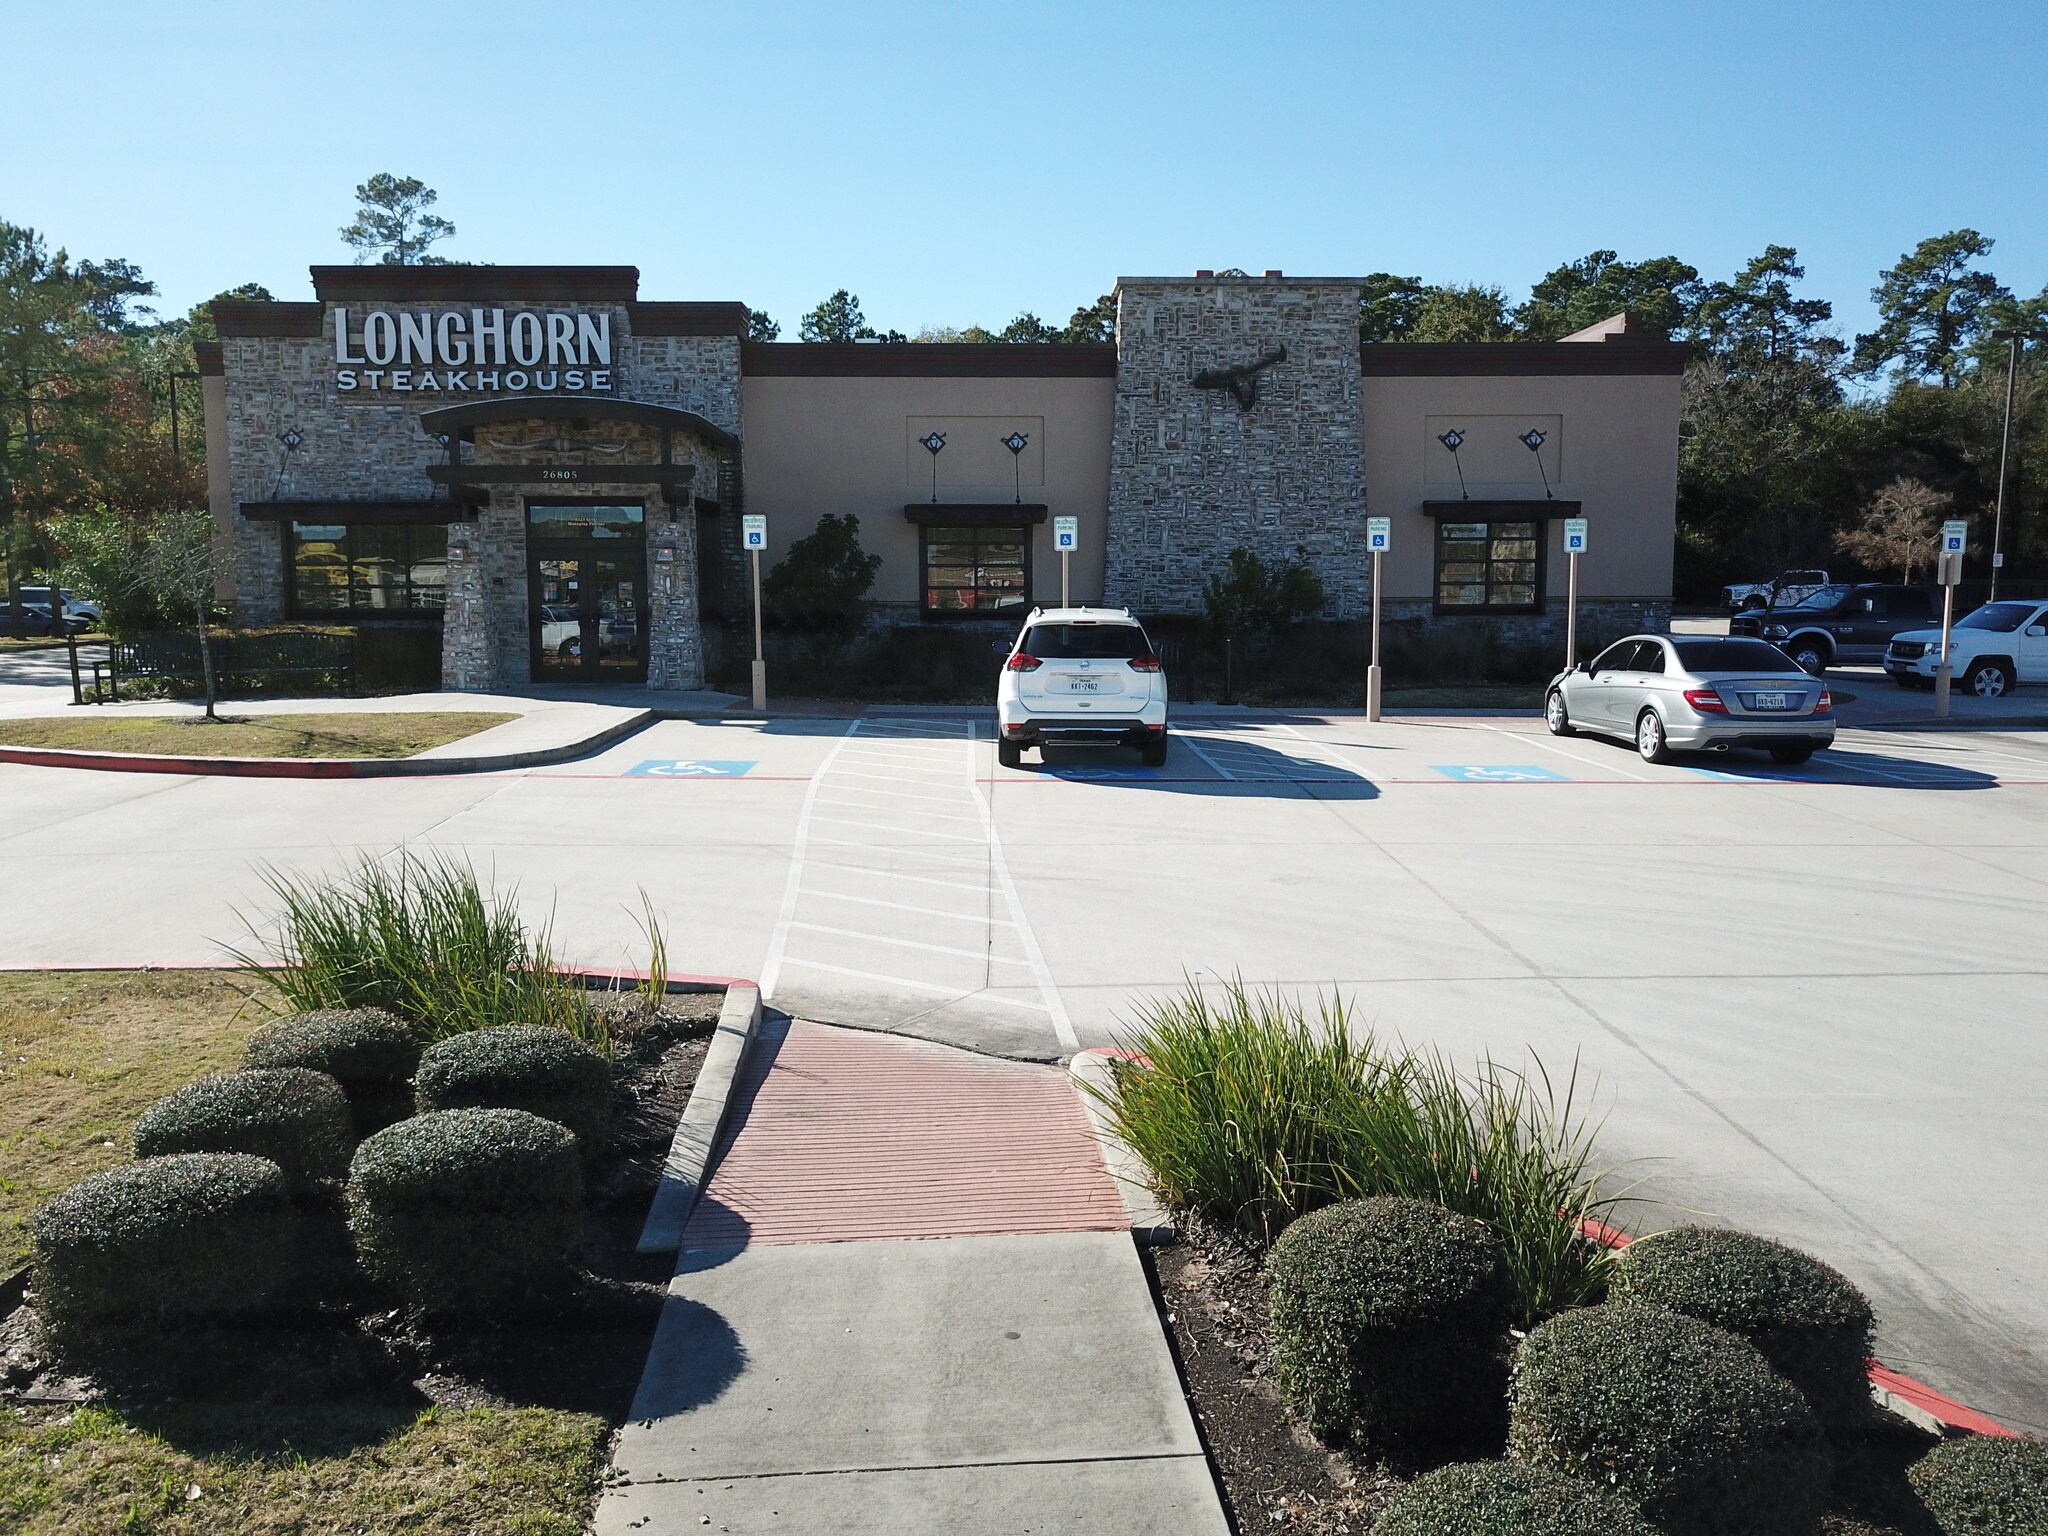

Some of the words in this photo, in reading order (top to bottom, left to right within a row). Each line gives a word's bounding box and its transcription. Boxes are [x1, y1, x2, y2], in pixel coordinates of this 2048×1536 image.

[334, 308, 612, 366] LONGHORN
[337, 370, 612, 391] STEAKHOUSE
[543, 470, 577, 479] 26805
